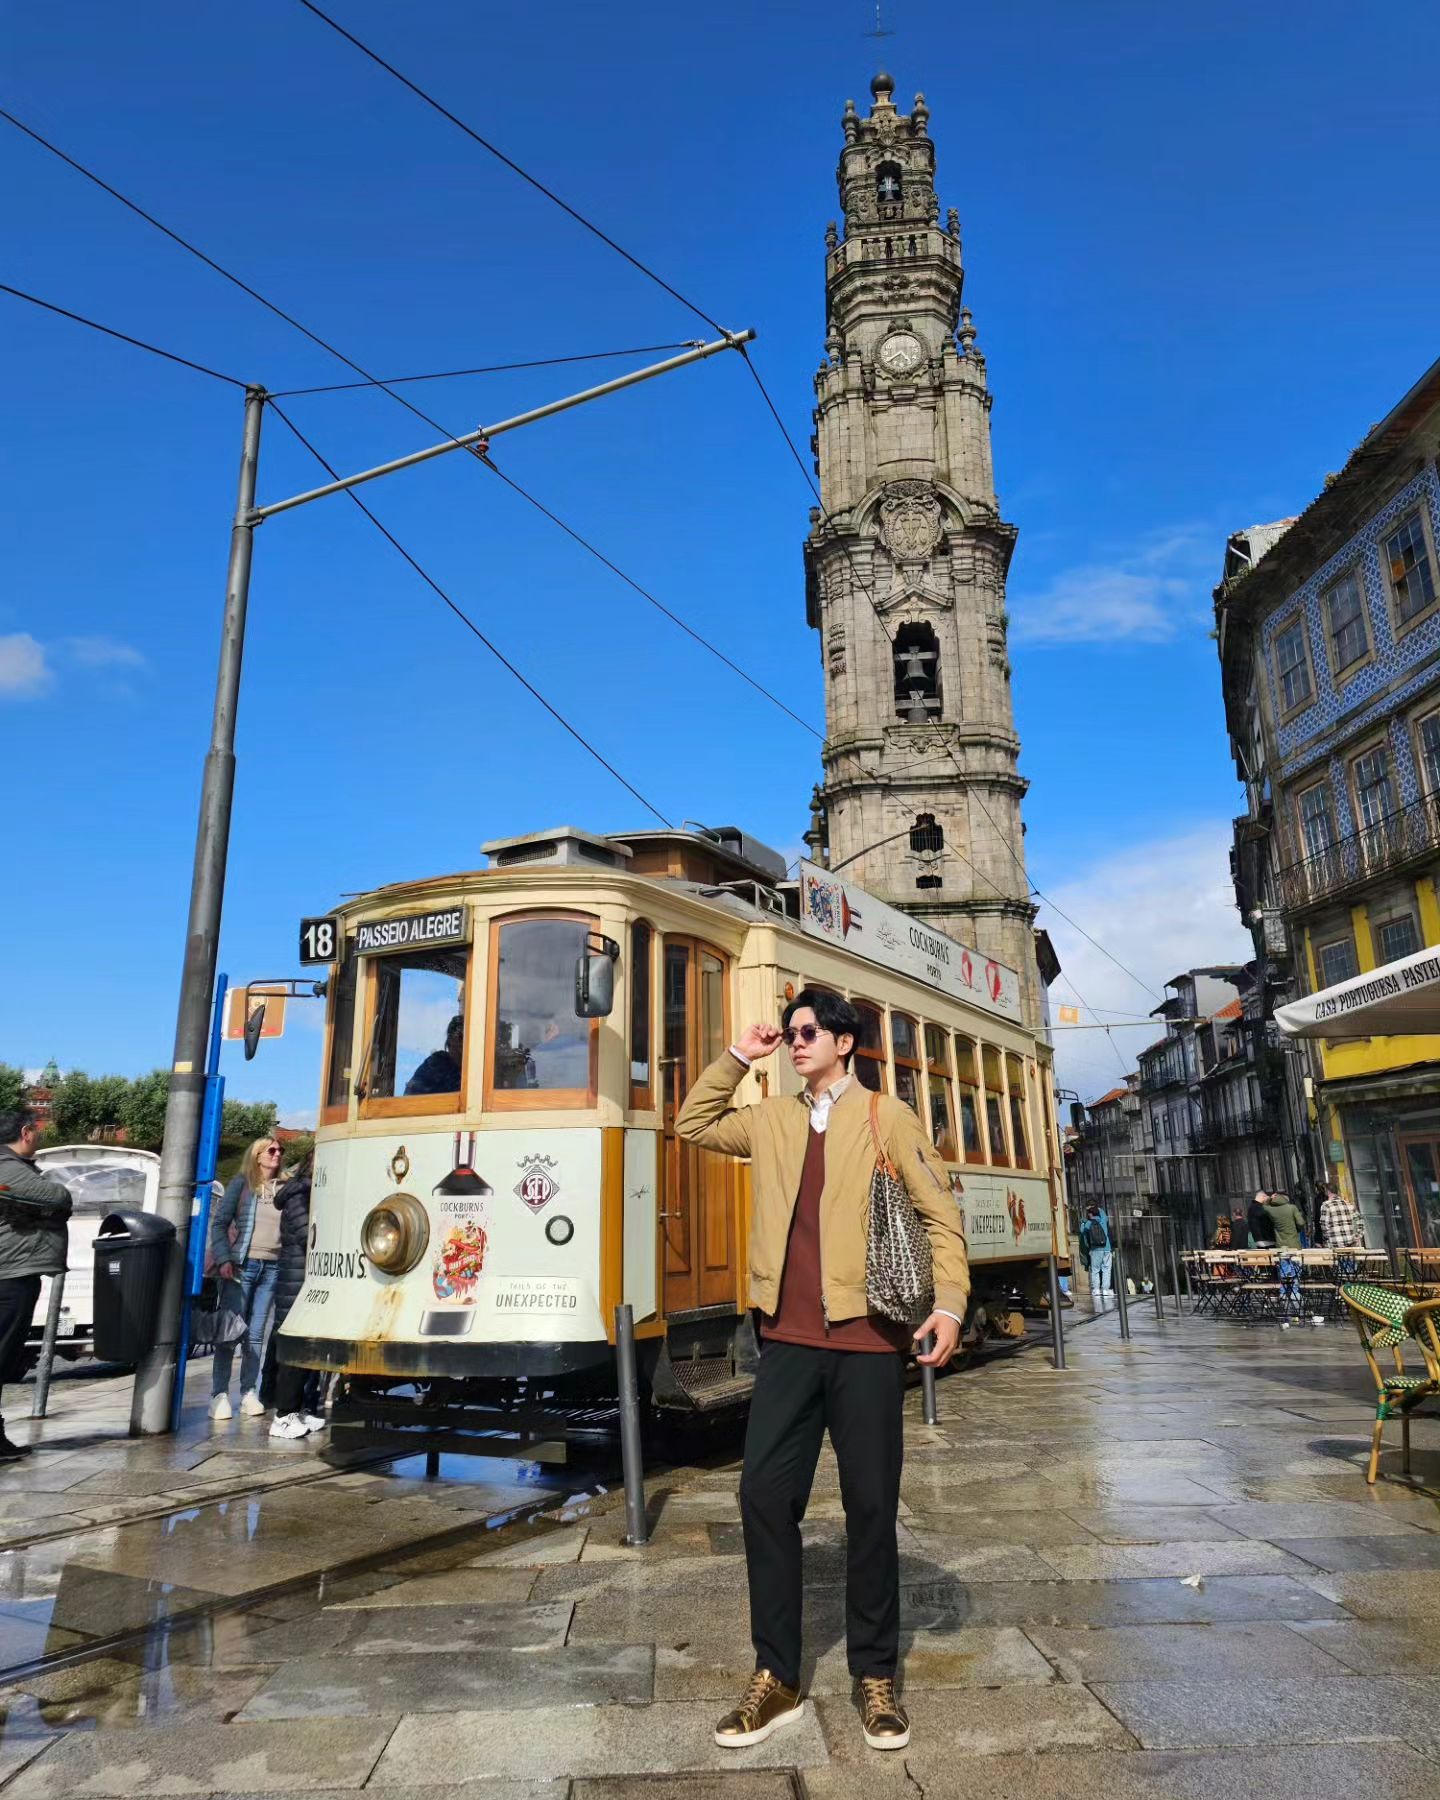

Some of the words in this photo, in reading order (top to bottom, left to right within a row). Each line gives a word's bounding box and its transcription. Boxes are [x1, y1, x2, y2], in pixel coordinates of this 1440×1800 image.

[304, 923, 333, 958] 18
[358, 919, 408, 949] PASSEIO
[410, 911, 460, 942] ALEGRE
[1315, 1000, 1337, 1020] CASA
[1338, 973, 1401, 1012] PORTUGUESA
[971, 1215, 1006, 1234] UNEXPECTED
[304, 1288, 330, 1304] PORTO
[496, 1293, 577, 1309] UNEXPECTED
